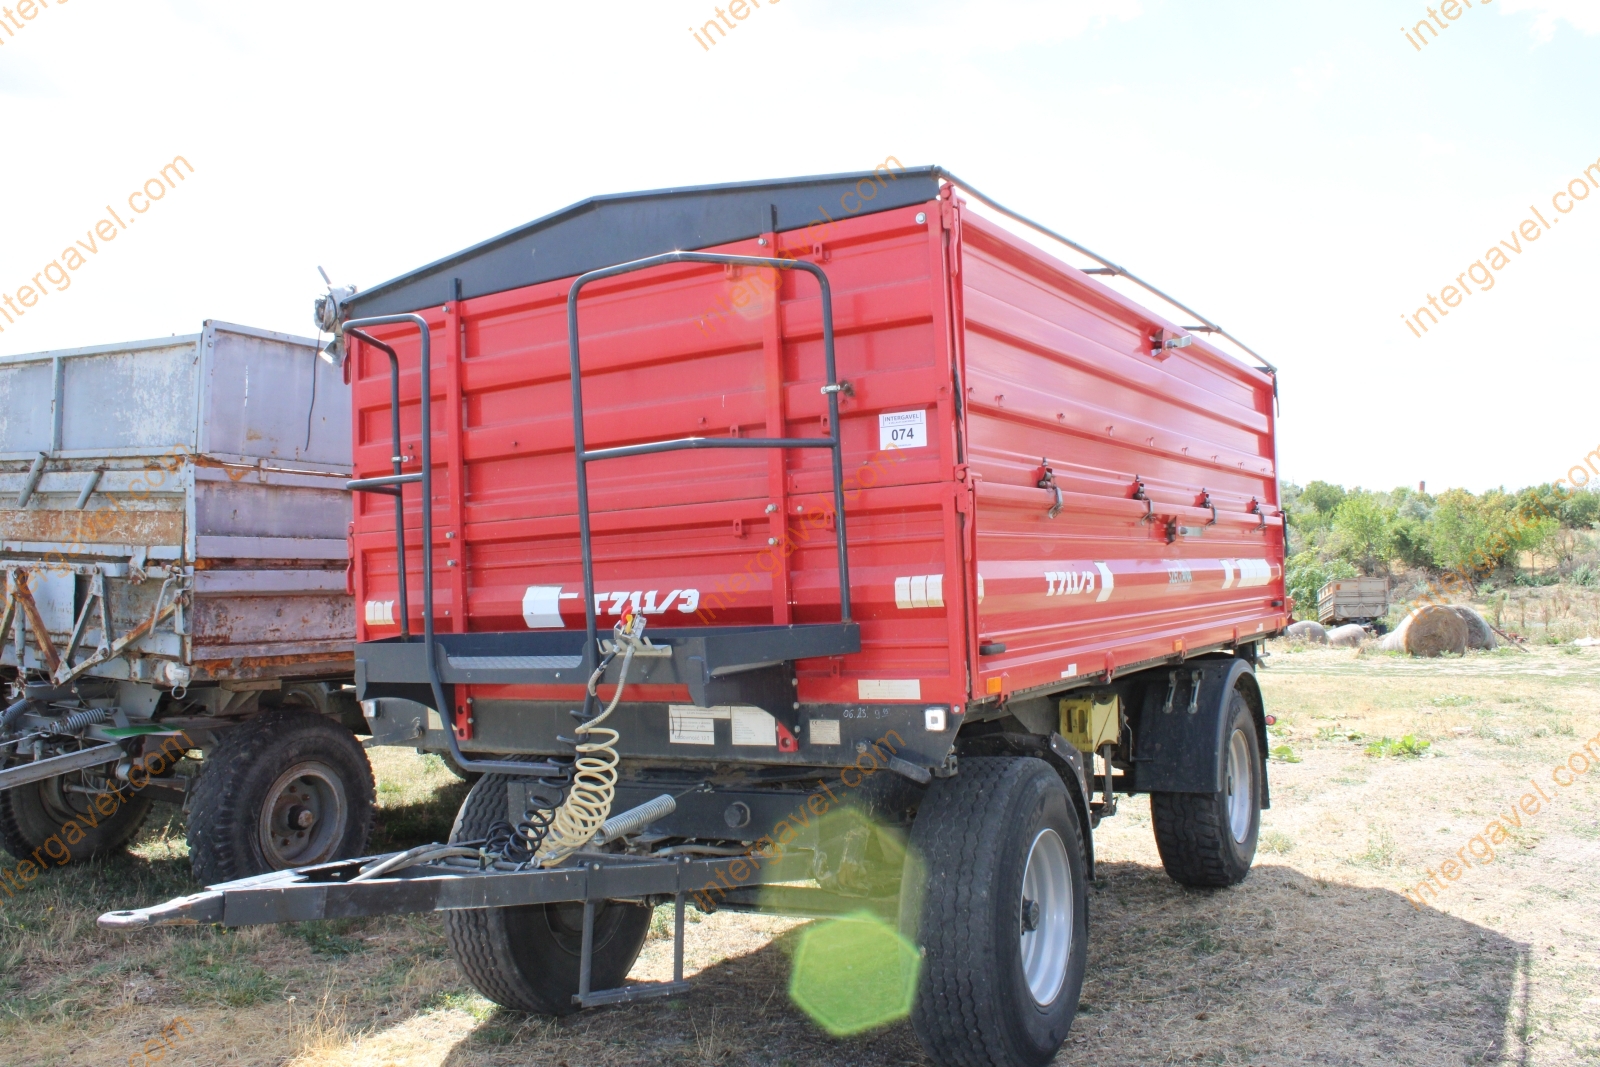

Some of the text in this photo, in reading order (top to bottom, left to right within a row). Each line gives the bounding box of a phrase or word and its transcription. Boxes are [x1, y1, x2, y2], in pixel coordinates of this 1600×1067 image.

[885, 413, 919, 422] INTERGAVEL
[891, 427, 914, 441] 074
[1044, 571, 1095, 597] T711/3
